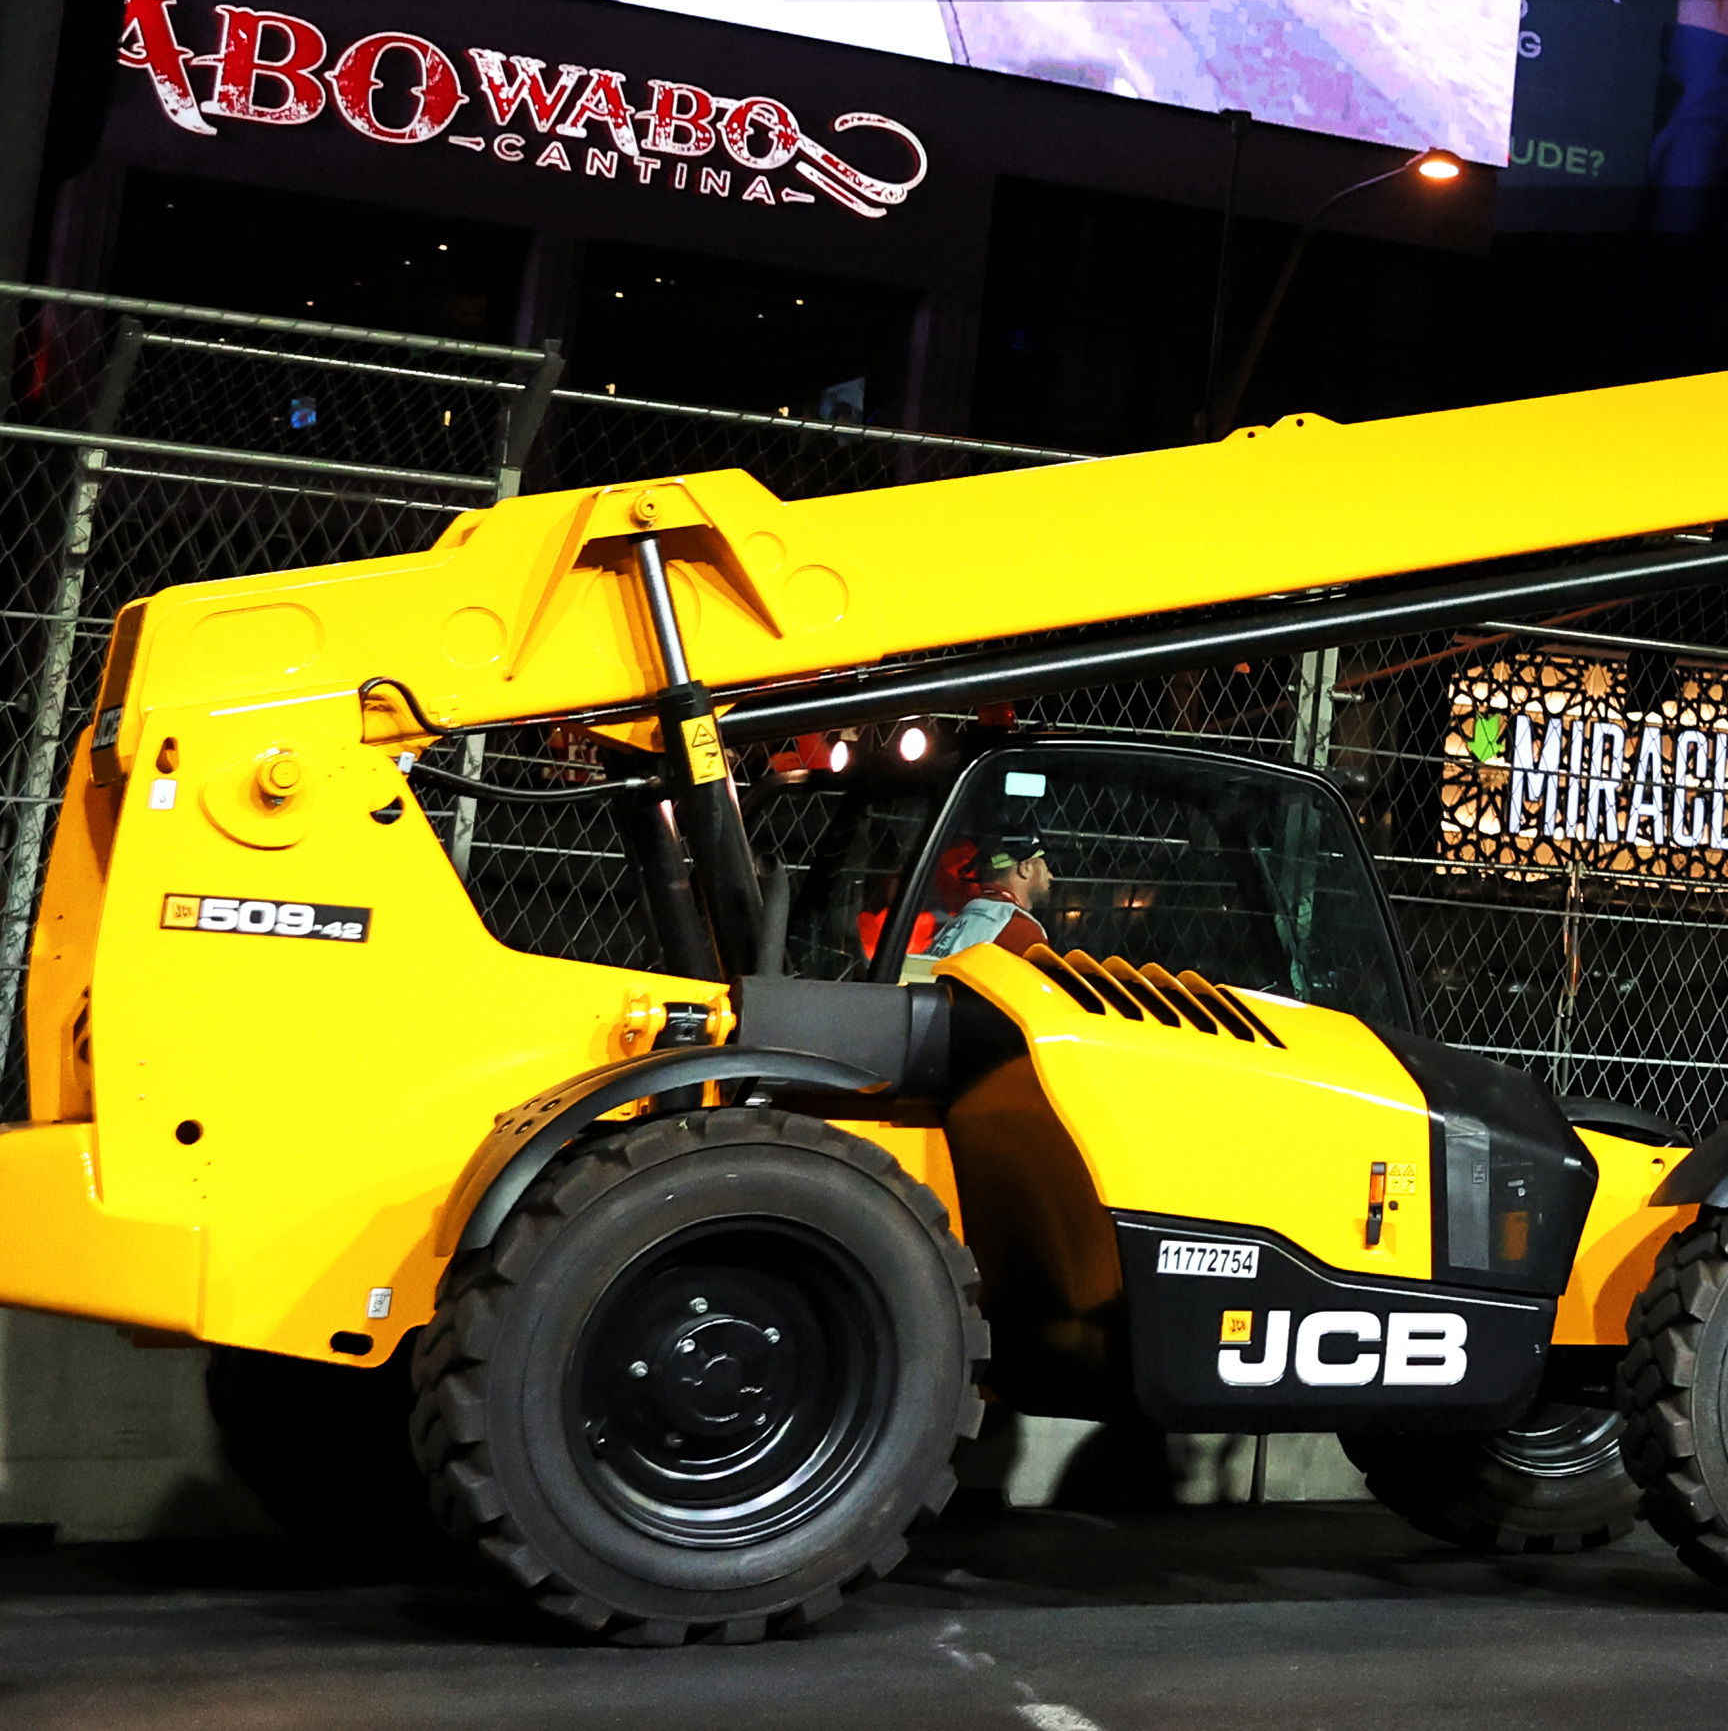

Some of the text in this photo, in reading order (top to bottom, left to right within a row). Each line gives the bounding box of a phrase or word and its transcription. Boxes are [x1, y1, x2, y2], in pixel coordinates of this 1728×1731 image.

[469, 47, 803, 170] WABO
[481, 133, 776, 208] CANTINA
[199, 898, 363, 941] 509-42
[1161, 1245, 1254, 1275] 11772754
[1217, 1310, 1468, 1386] JCB
